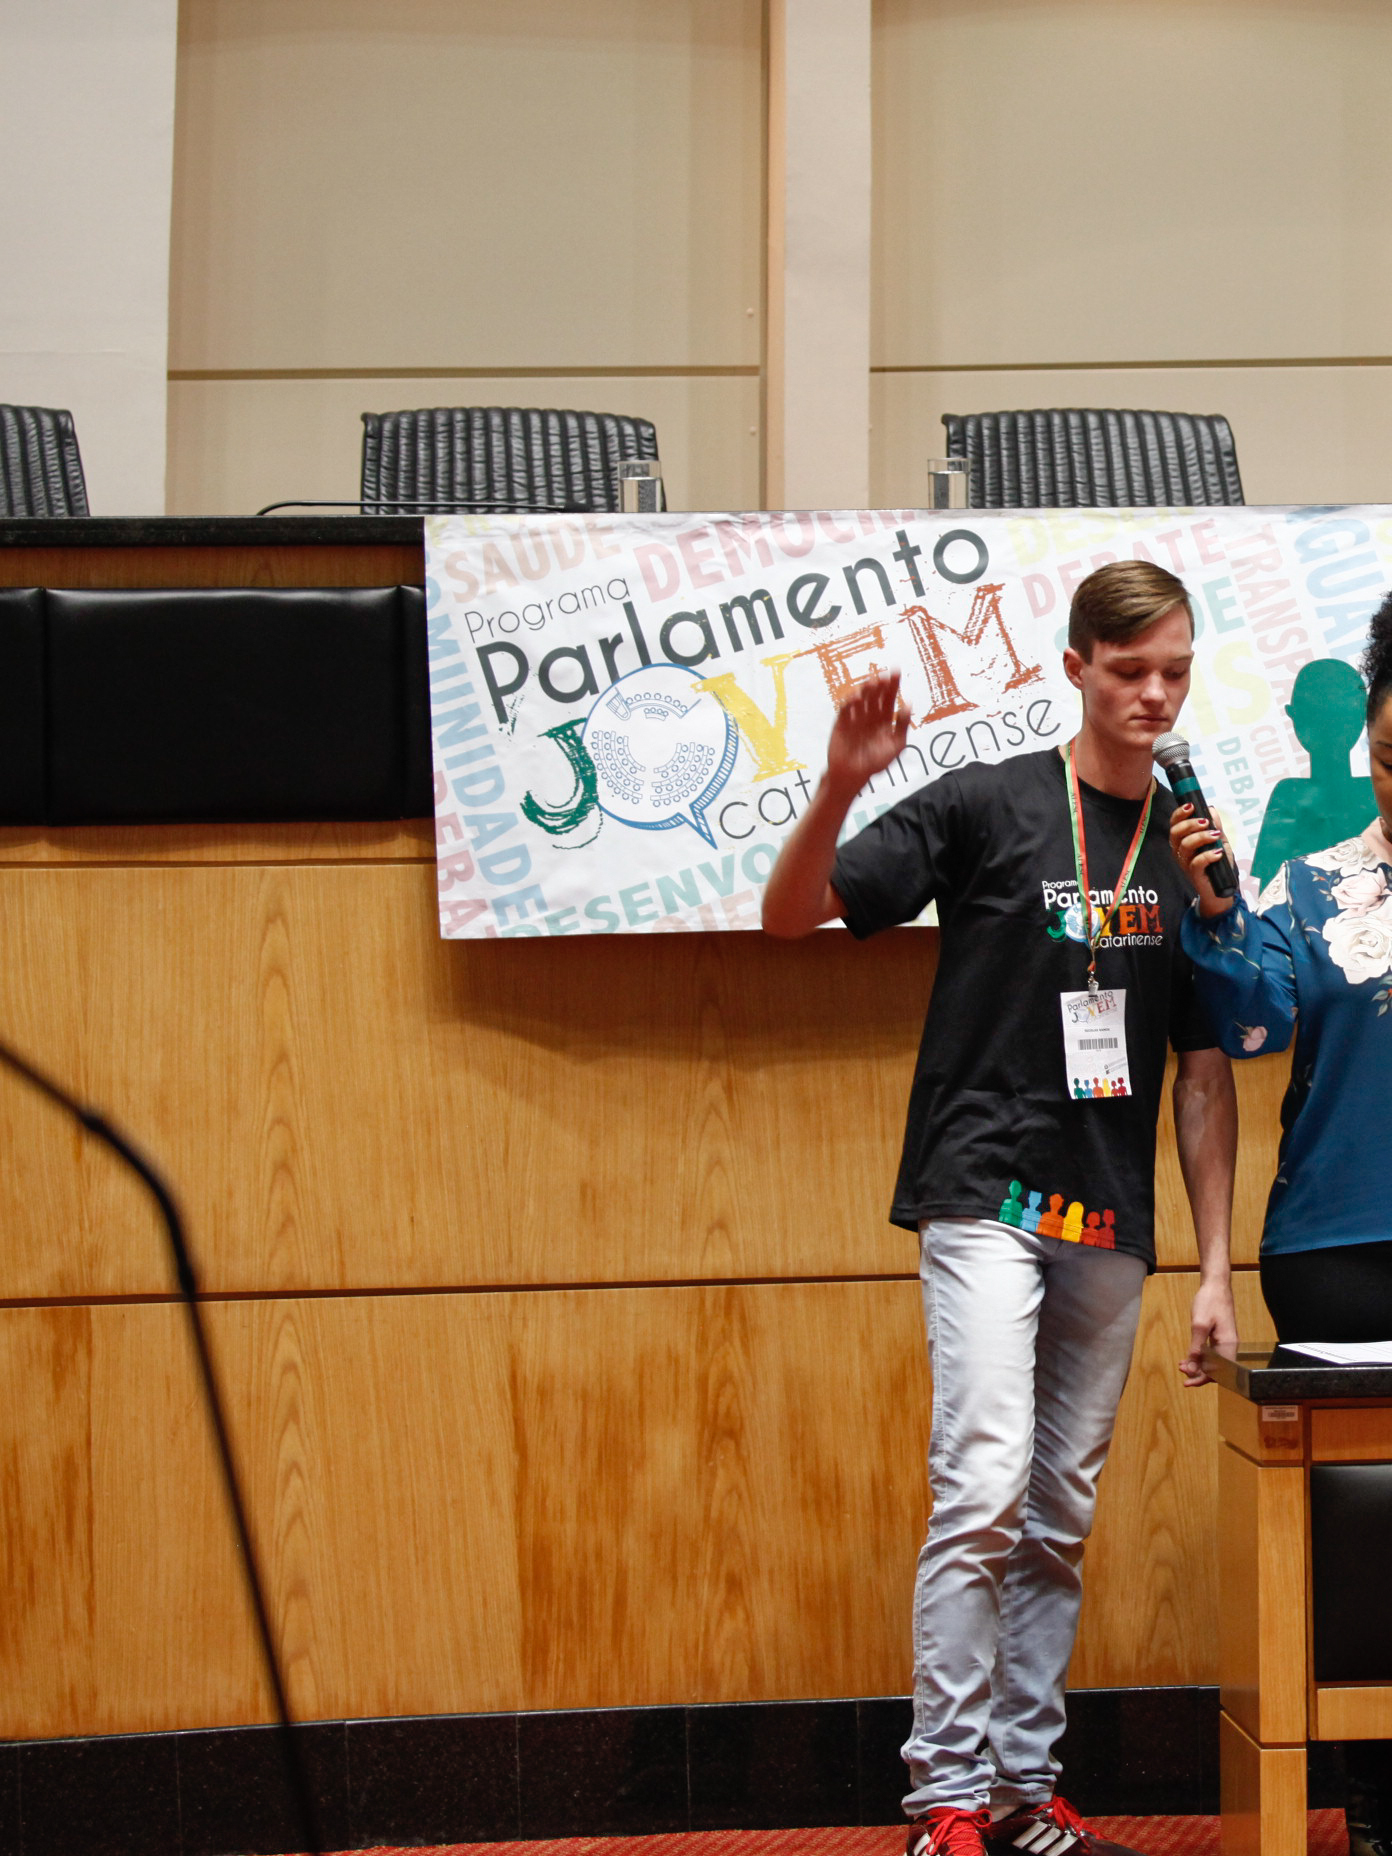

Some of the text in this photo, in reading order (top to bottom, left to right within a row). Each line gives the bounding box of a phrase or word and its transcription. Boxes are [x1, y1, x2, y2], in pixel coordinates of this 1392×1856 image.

[464, 577, 631, 644] Programa
[475, 528, 990, 735] Parlamento
[718, 700, 1062, 840] catnense
[1042, 880, 1079, 890] Program
[1043, 886, 1159, 910] Paramnto
